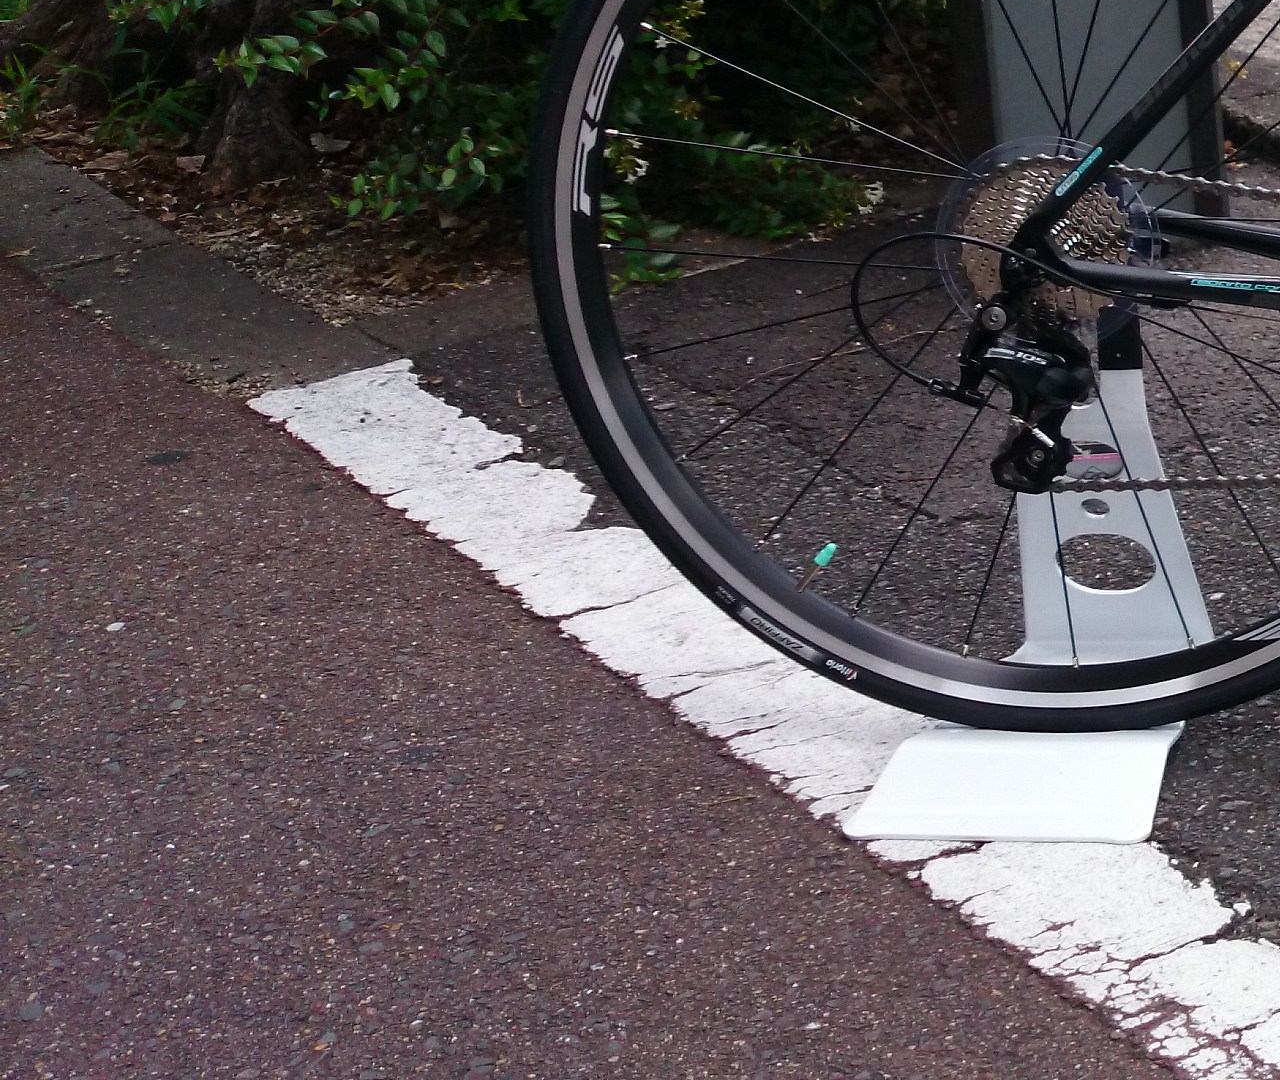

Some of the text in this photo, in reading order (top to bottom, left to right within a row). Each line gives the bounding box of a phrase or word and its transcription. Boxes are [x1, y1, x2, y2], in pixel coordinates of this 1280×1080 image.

[1190, 279, 1252, 291] reparto
[1015, 351, 1049, 366] 105
[750, 617, 804, 652] ZAFFIRO
[825, 658, 858, 681] Vittoria
